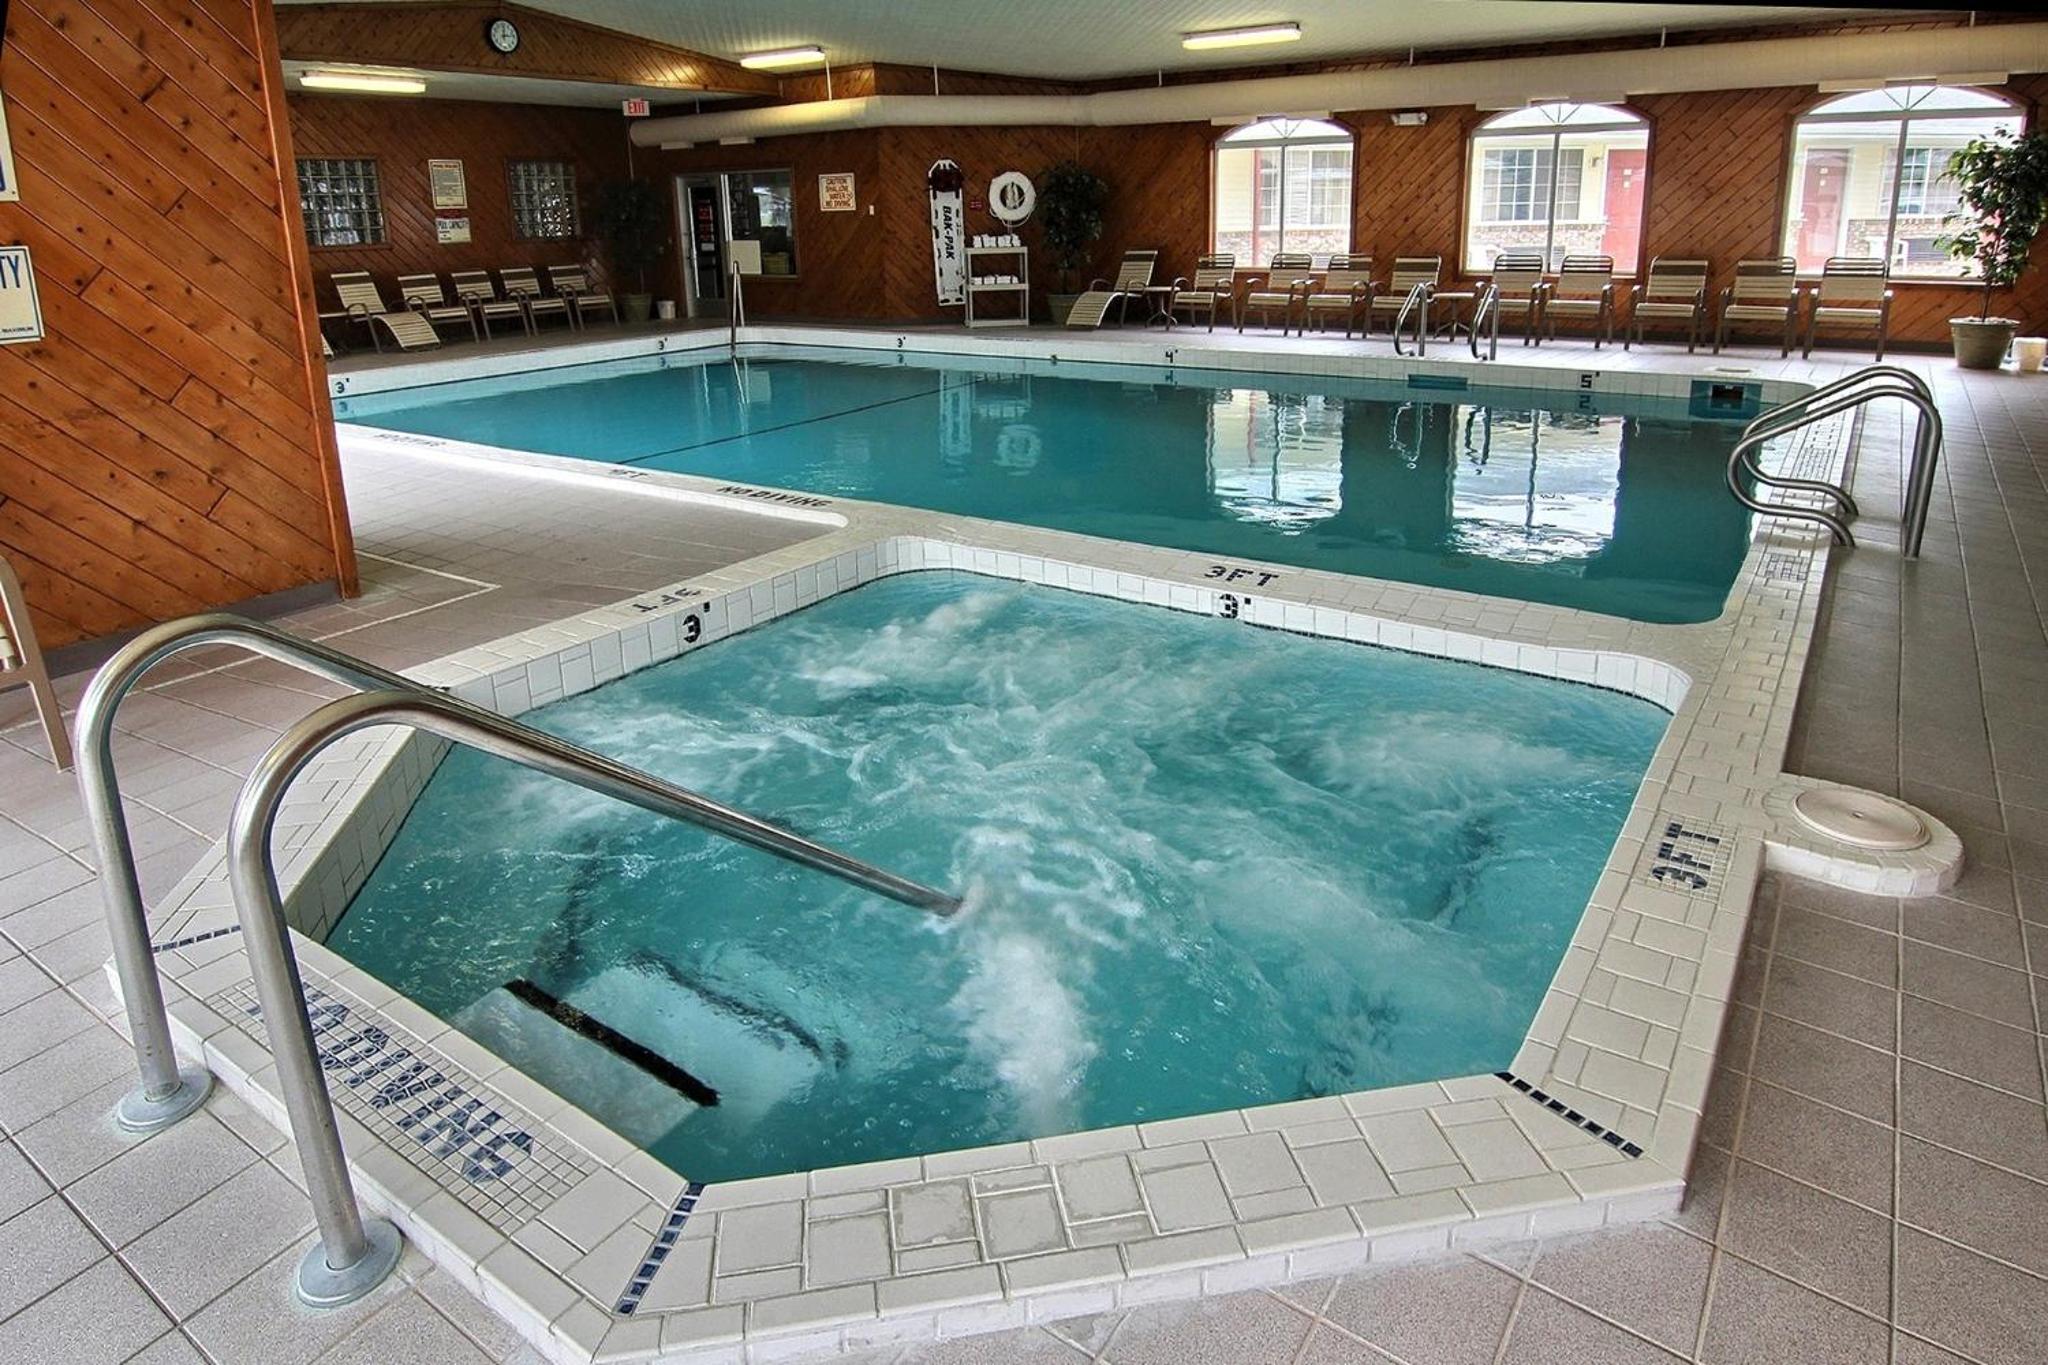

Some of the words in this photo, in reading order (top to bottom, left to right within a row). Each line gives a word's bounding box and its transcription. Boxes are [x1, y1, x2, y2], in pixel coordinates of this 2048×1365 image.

[627, 101, 645, 114] EXIT
[943, 205, 956, 260] BAK-PAK
[748, 491, 833, 507] DIVING
[1204, 565, 1279, 587] 3FT
[683, 601, 711, 644] 3'
[1219, 593, 1252, 619] 3'
[1652, 822, 1720, 889] 3FT
[318, 1024, 535, 1184] DIVING
